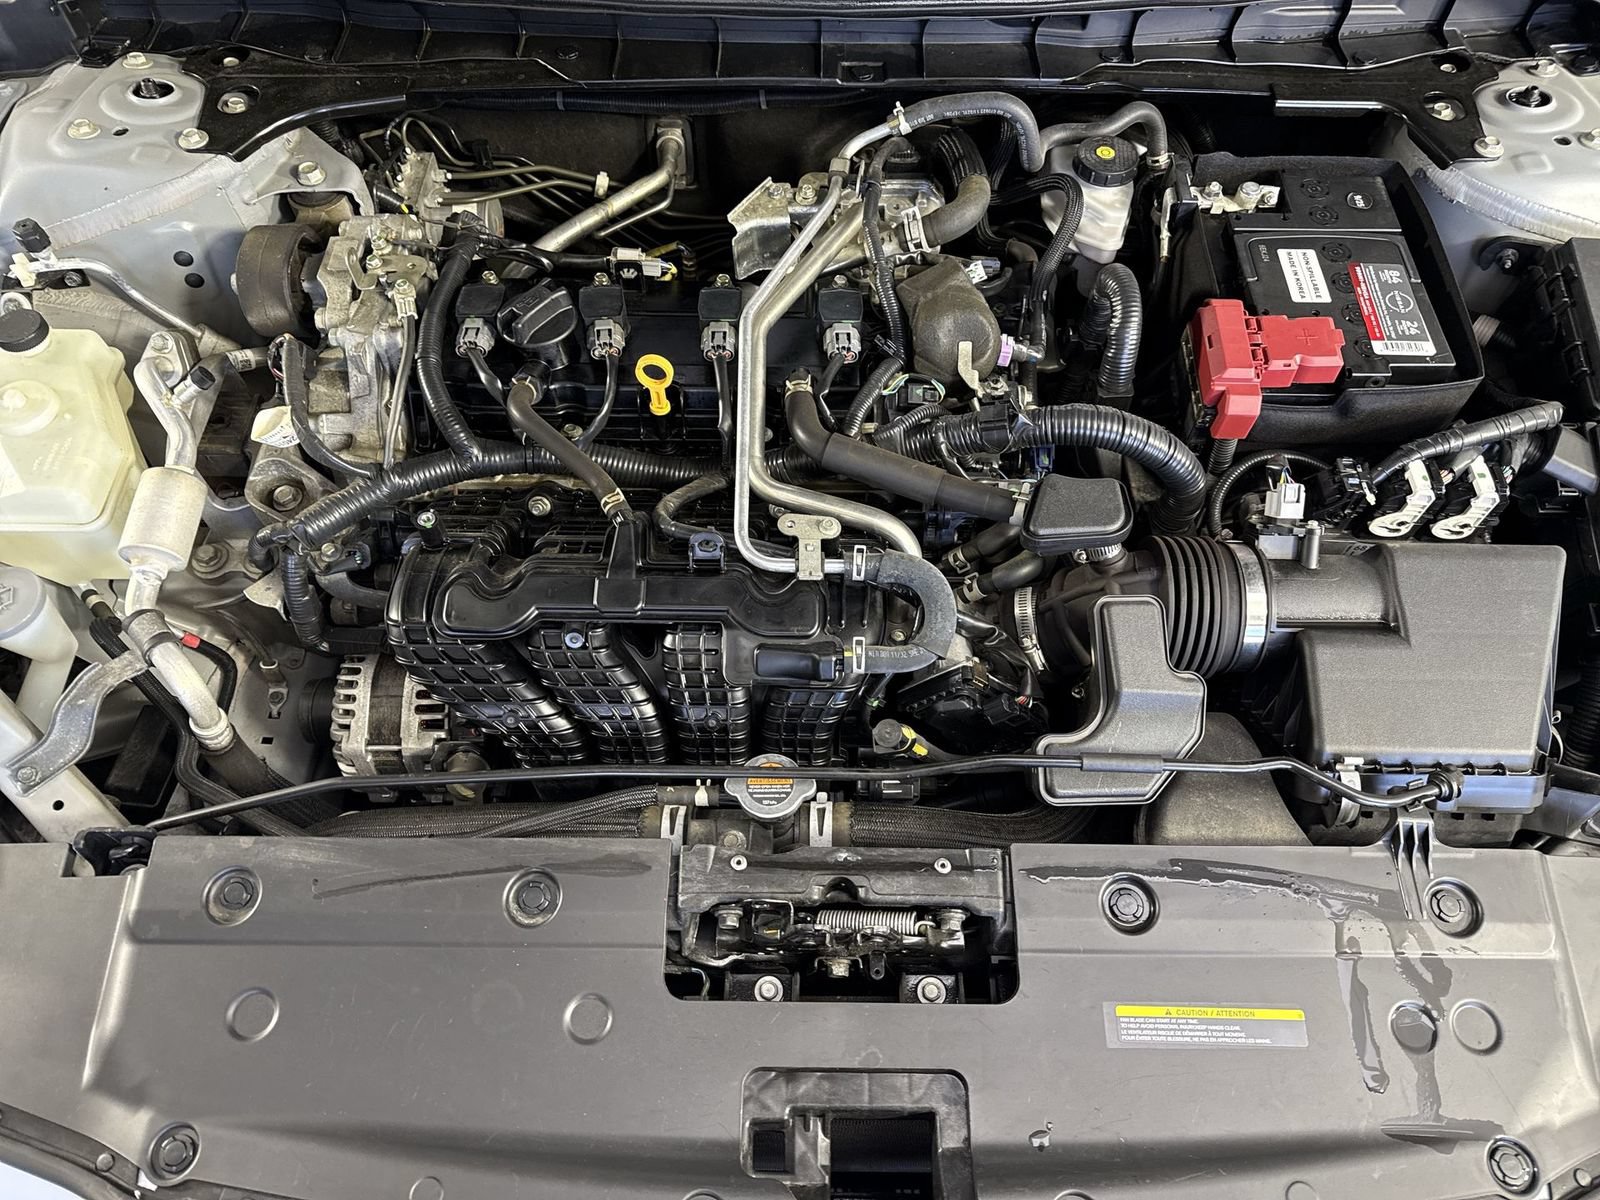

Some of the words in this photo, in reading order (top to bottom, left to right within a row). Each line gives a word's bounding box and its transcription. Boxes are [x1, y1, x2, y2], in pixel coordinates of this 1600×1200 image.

[1286, 251, 1297, 268] MADE
[1291, 269, 1299, 277] IN
[1388, 270, 1403, 284] 84
[1294, 278, 1307, 300] KOREA
[1393, 290, 1407, 314] NISSAN
[1406, 320, 1421, 336] 24
